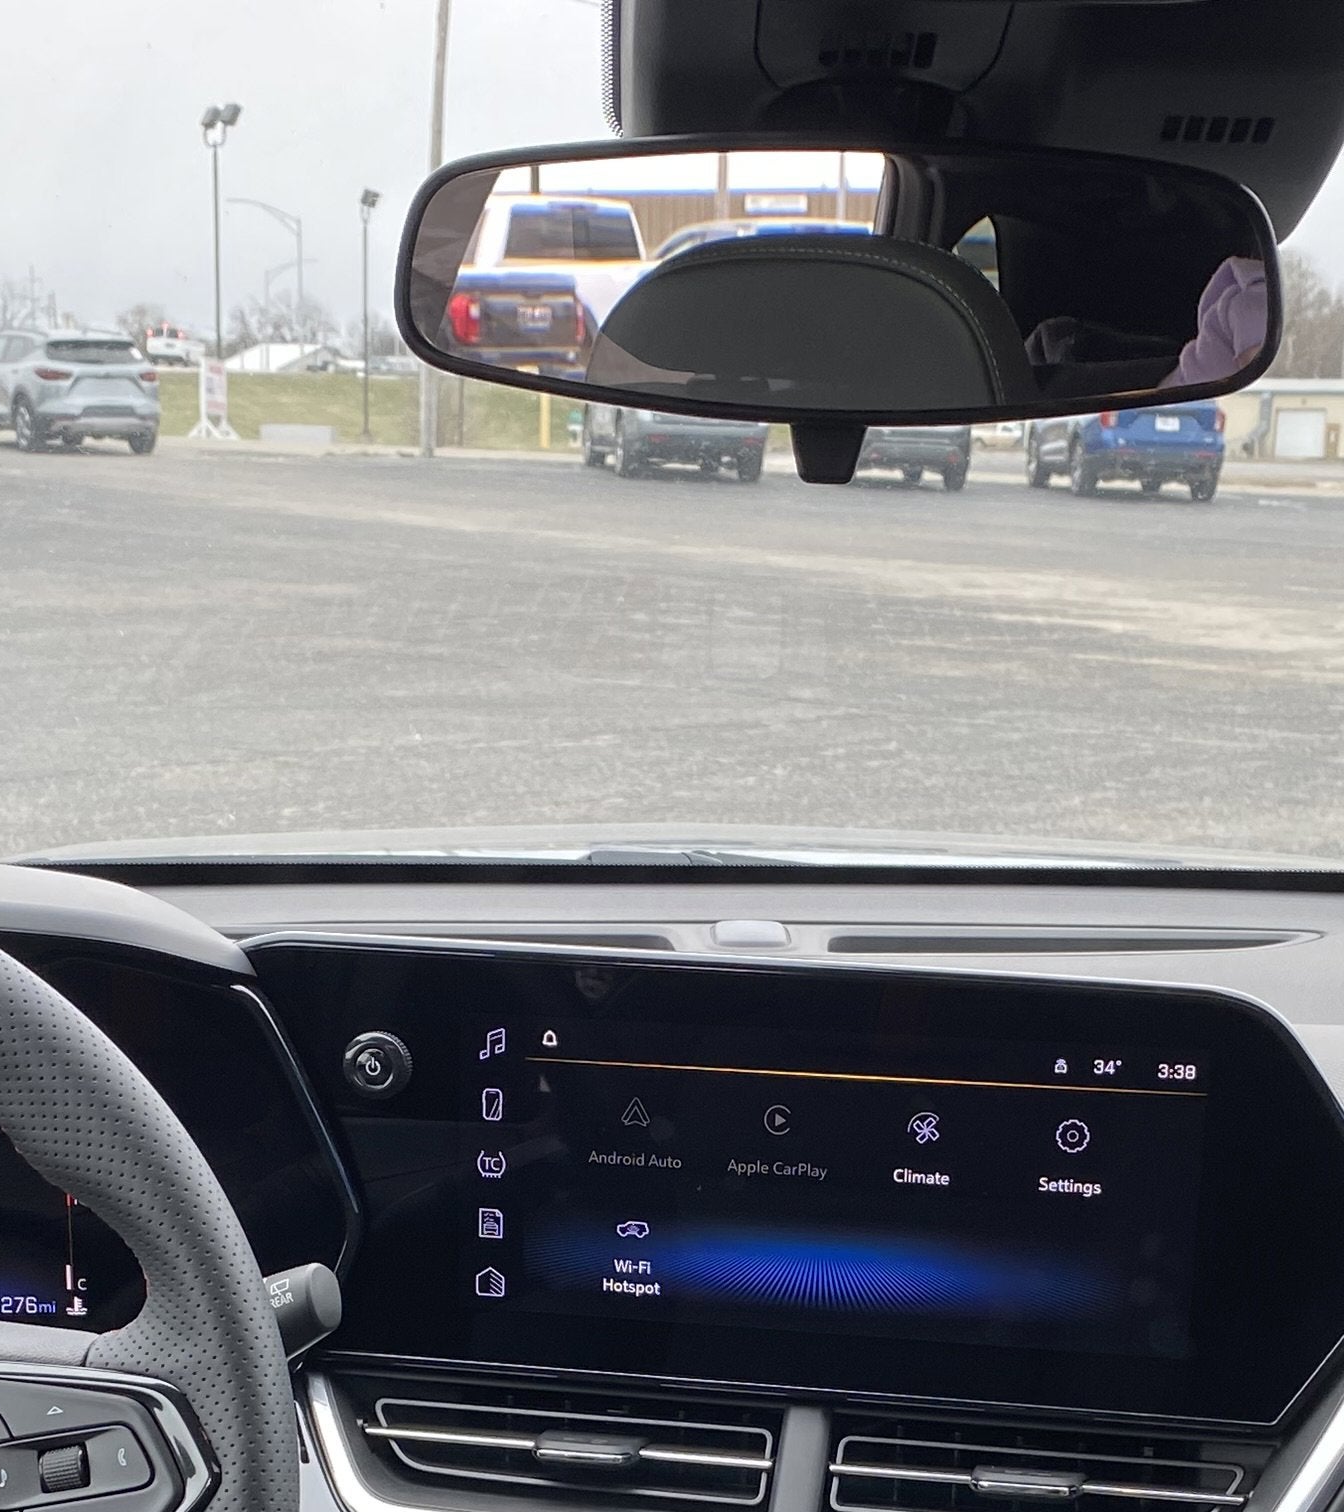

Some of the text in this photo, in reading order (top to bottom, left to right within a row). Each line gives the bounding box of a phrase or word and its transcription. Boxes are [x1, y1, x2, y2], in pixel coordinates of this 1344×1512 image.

[1093, 1058, 1197, 1081] 34° 3:38
[588, 1149, 683, 1170] Android Auto
[727, 1157, 828, 1181] Apple CarPlay
[892, 1167, 951, 1187] Climate
[1037, 1175, 1103, 1198] Settings
[613, 1258, 652, 1276] Wi-Fi
[77, 1278, 88, 1291] C
[601, 1276, 661, 1298] Hotspot
